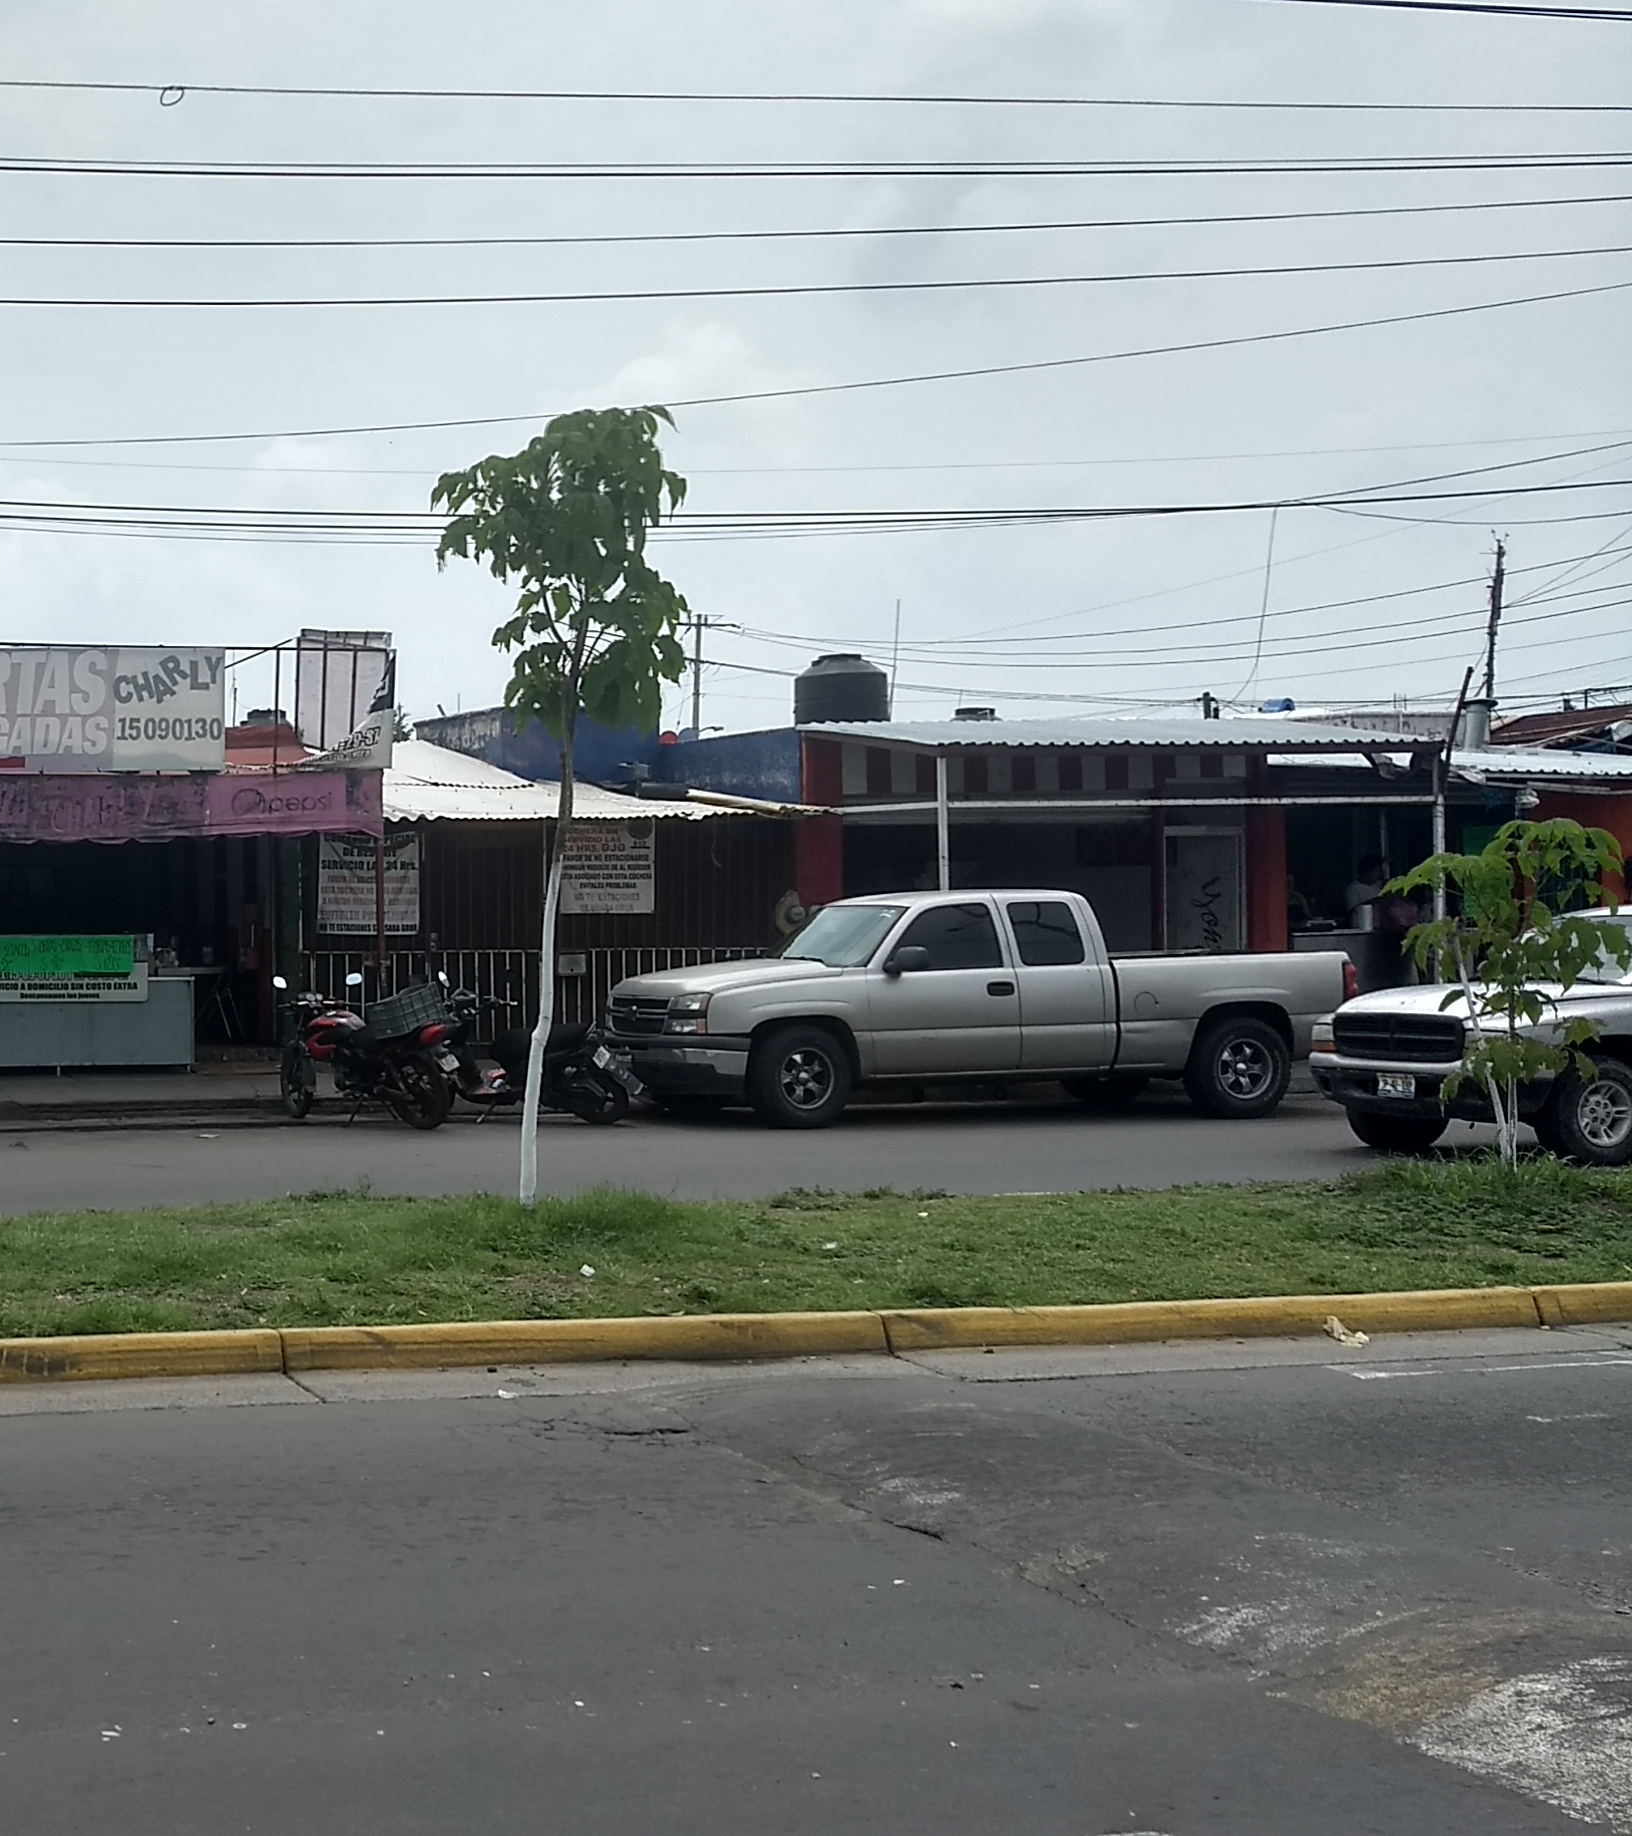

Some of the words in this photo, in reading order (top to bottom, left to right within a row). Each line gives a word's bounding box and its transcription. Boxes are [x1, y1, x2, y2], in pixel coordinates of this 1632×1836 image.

[113, 655, 224, 704] CHARLY
[118, 717, 222, 741] 15090130
[268, 791, 333, 815] pepsi
[343, 847, 356, 857] DE
[601, 843, 626, 852] OJO
[321, 860, 365, 871] SERVICIO
[385, 861, 398, 871] 24
[20, 983, 27, 991] A
[28, 982, 68, 991] DOMICILIO
[70, 982, 85, 991] SIN
[87, 982, 112, 991] COSTO
[113, 982, 138, 991] EXTRA
